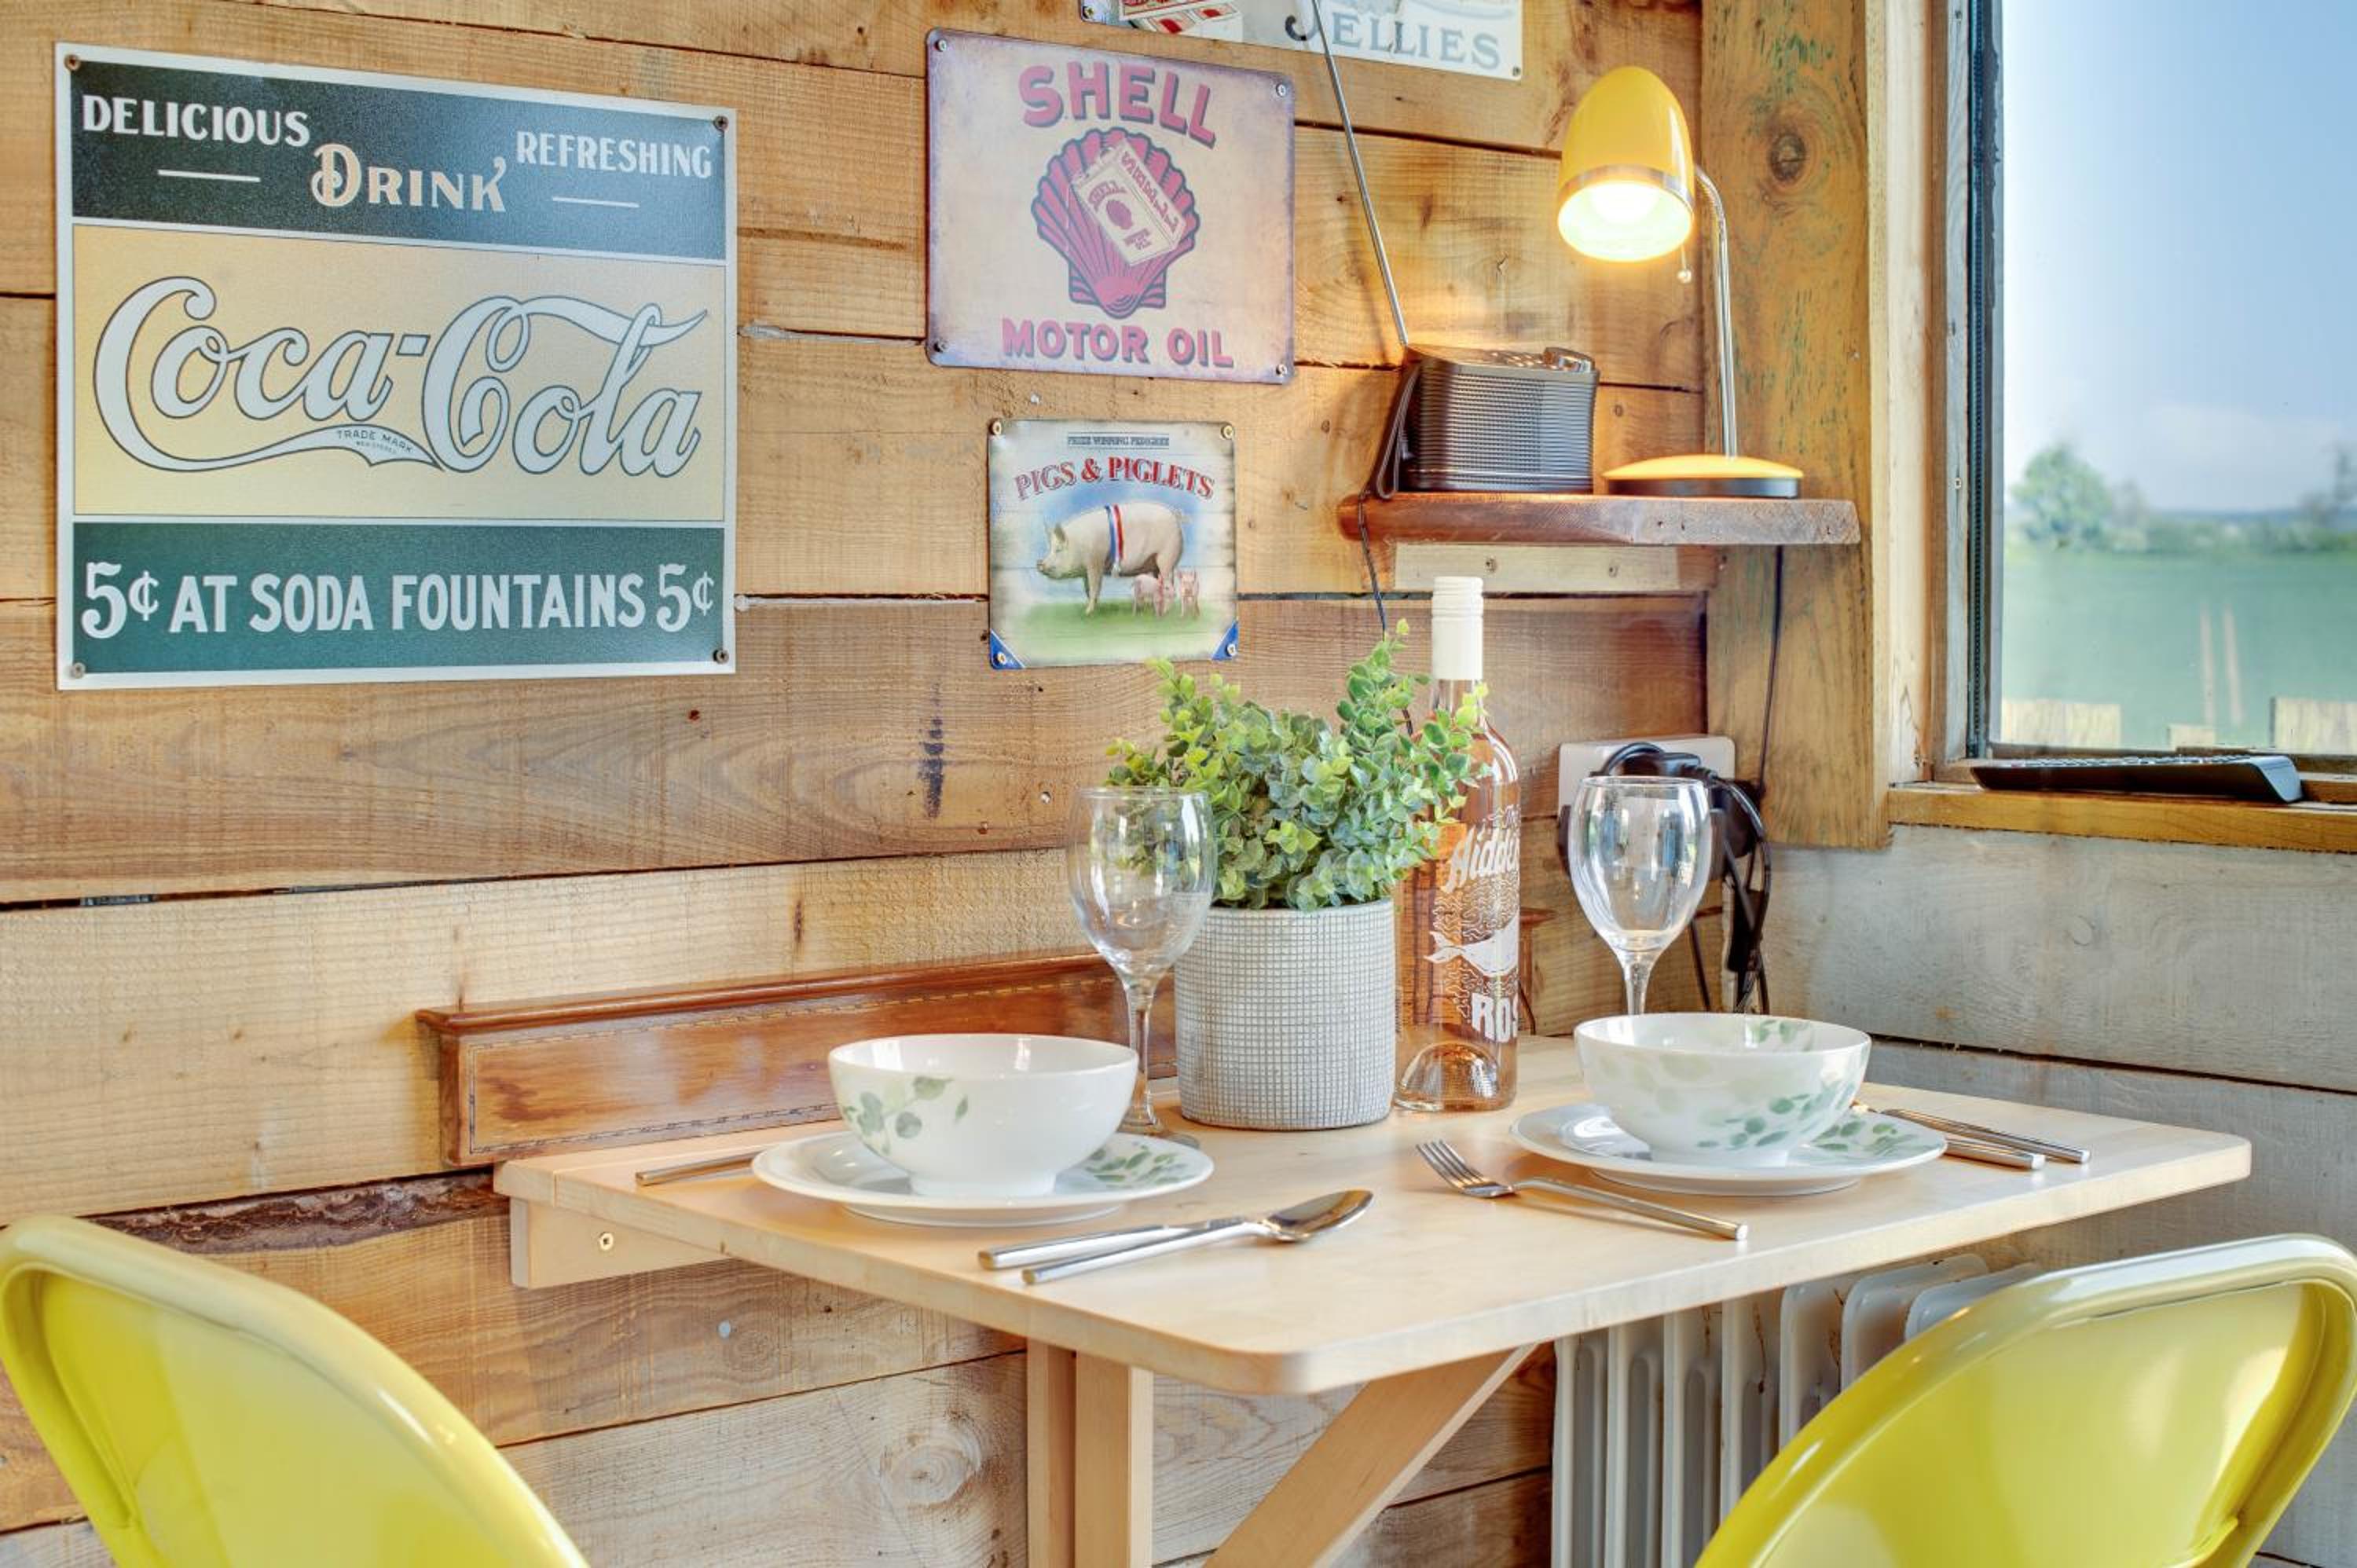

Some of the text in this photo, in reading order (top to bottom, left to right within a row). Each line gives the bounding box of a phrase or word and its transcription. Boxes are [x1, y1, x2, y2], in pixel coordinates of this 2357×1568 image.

[82, 94, 310, 148] DELICIOUS
[1017, 61, 1217, 150] SHELL
[516, 130, 712, 178] REFRESHING
[1002, 318, 1235, 368] MOTOR OIL
[93, 276, 707, 477] Coca-Cola
[337, 430, 376, 440] TRADE
[382, 434, 413, 452] MARK
[1014, 456, 1215, 500] PIGS & PIGLETS
[81, 561, 715, 639] 5¢ AT SODA FOUNTAINS 5¢
